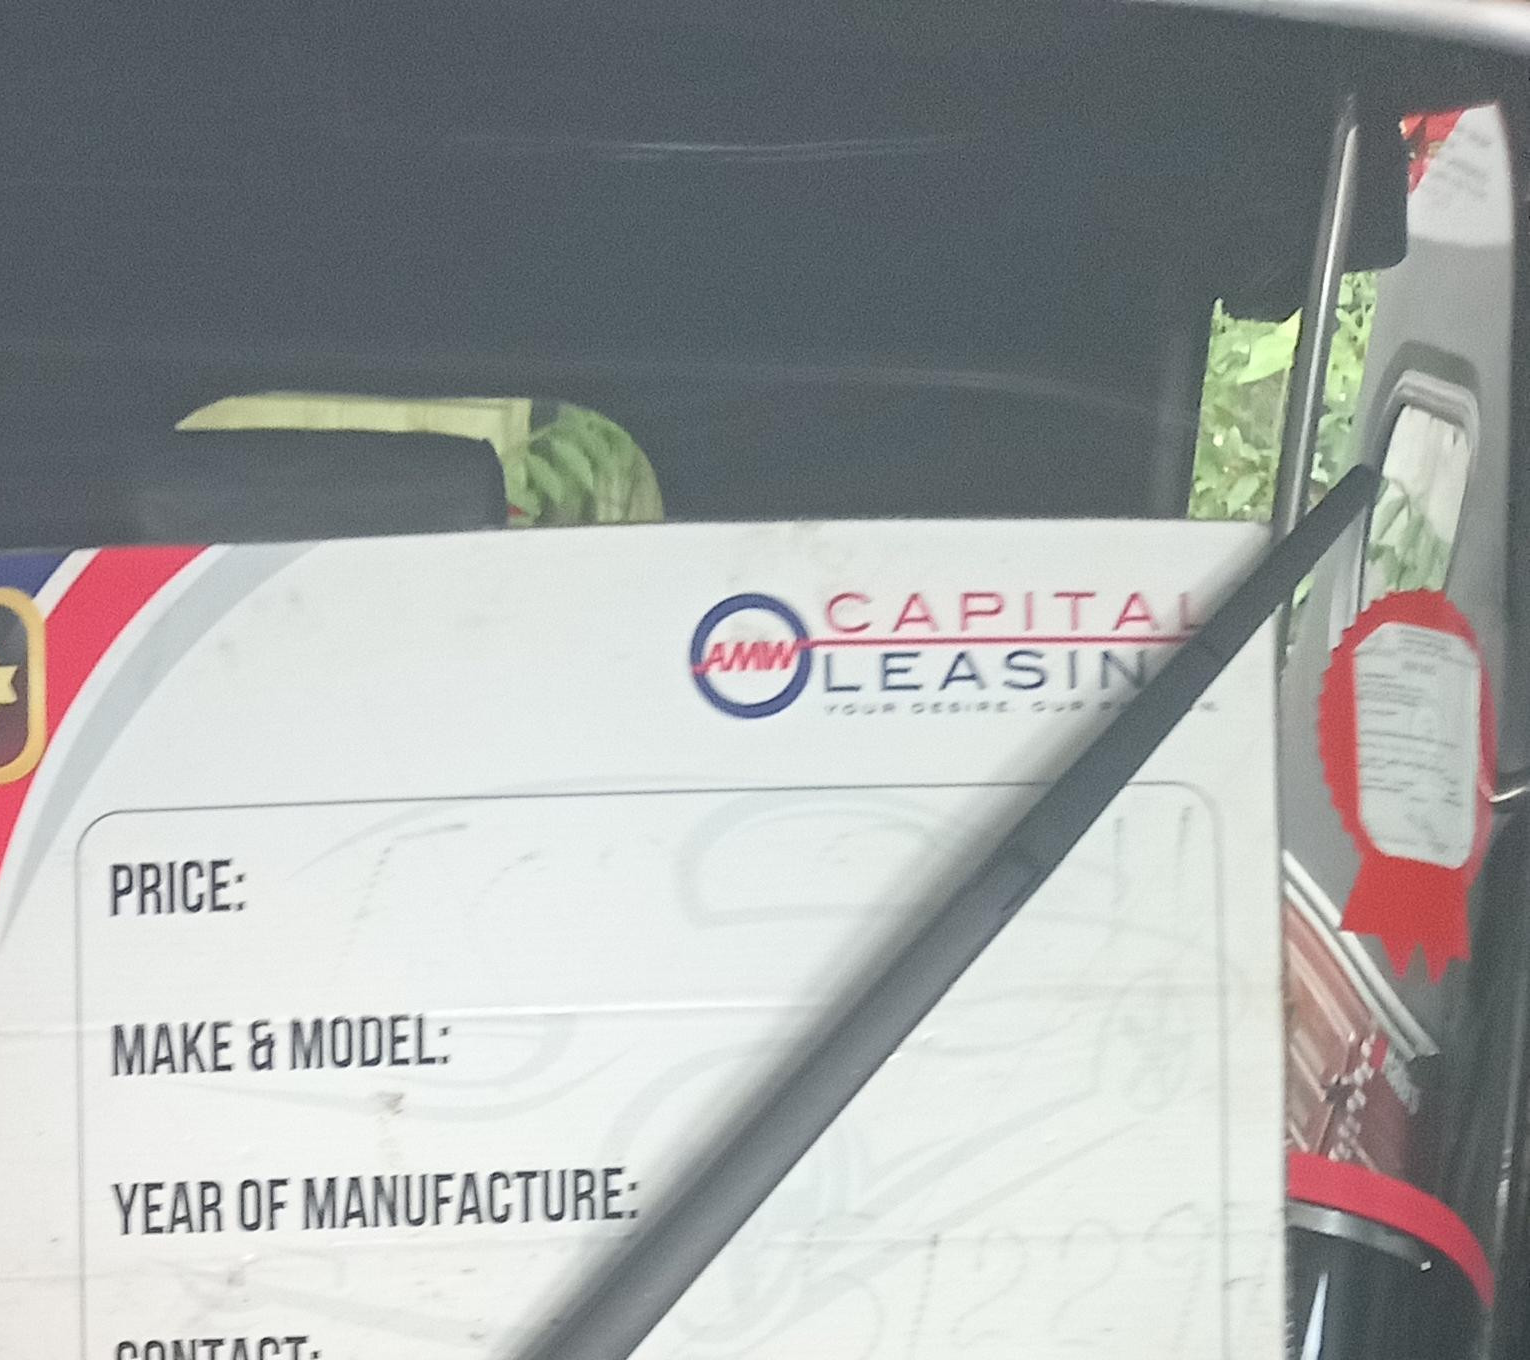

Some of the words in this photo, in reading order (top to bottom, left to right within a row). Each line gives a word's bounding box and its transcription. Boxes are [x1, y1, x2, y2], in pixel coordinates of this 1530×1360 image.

[823, 592, 1204, 633] CAPITAL
[823, 649, 1154, 692] LEASIN
[109, 858, 247, 915] PRICE:
[111, 1020, 234, 1077] MAKE
[249, 1020, 274, 1071] &
[290, 1014, 451, 1070] MODEL:
[112, 1180, 223, 1236] YEAR
[239, 1177, 290, 1230] OF
[302, 1166, 639, 1229] MANUFACTURE:
